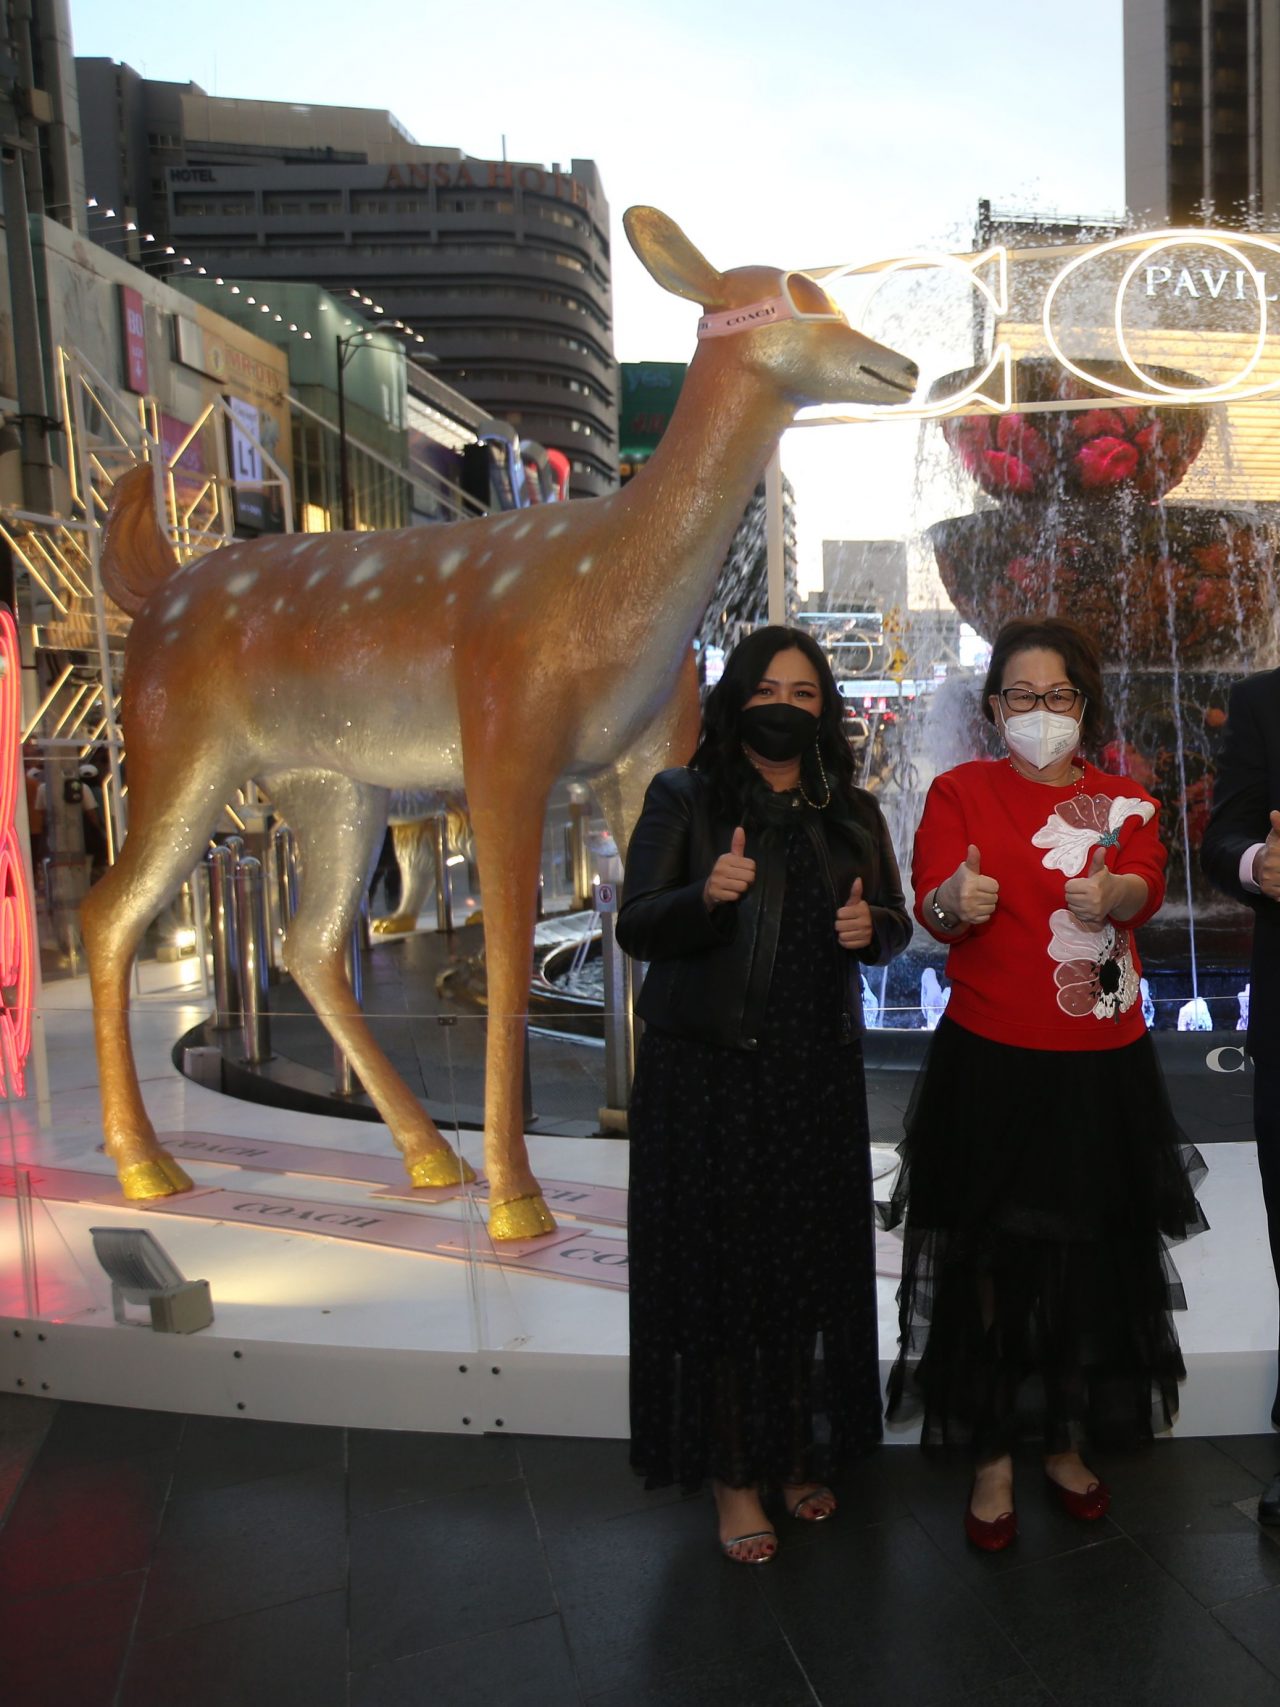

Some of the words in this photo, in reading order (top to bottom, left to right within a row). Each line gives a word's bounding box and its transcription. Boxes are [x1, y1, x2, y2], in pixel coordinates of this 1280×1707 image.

[169, 167, 217, 184] HOTEL
[384, 162, 476, 189] ANSA
[726, 306, 776, 326] COACH
[238, 440, 257, 478] L1
[232, 1202, 383, 1229] COACH
